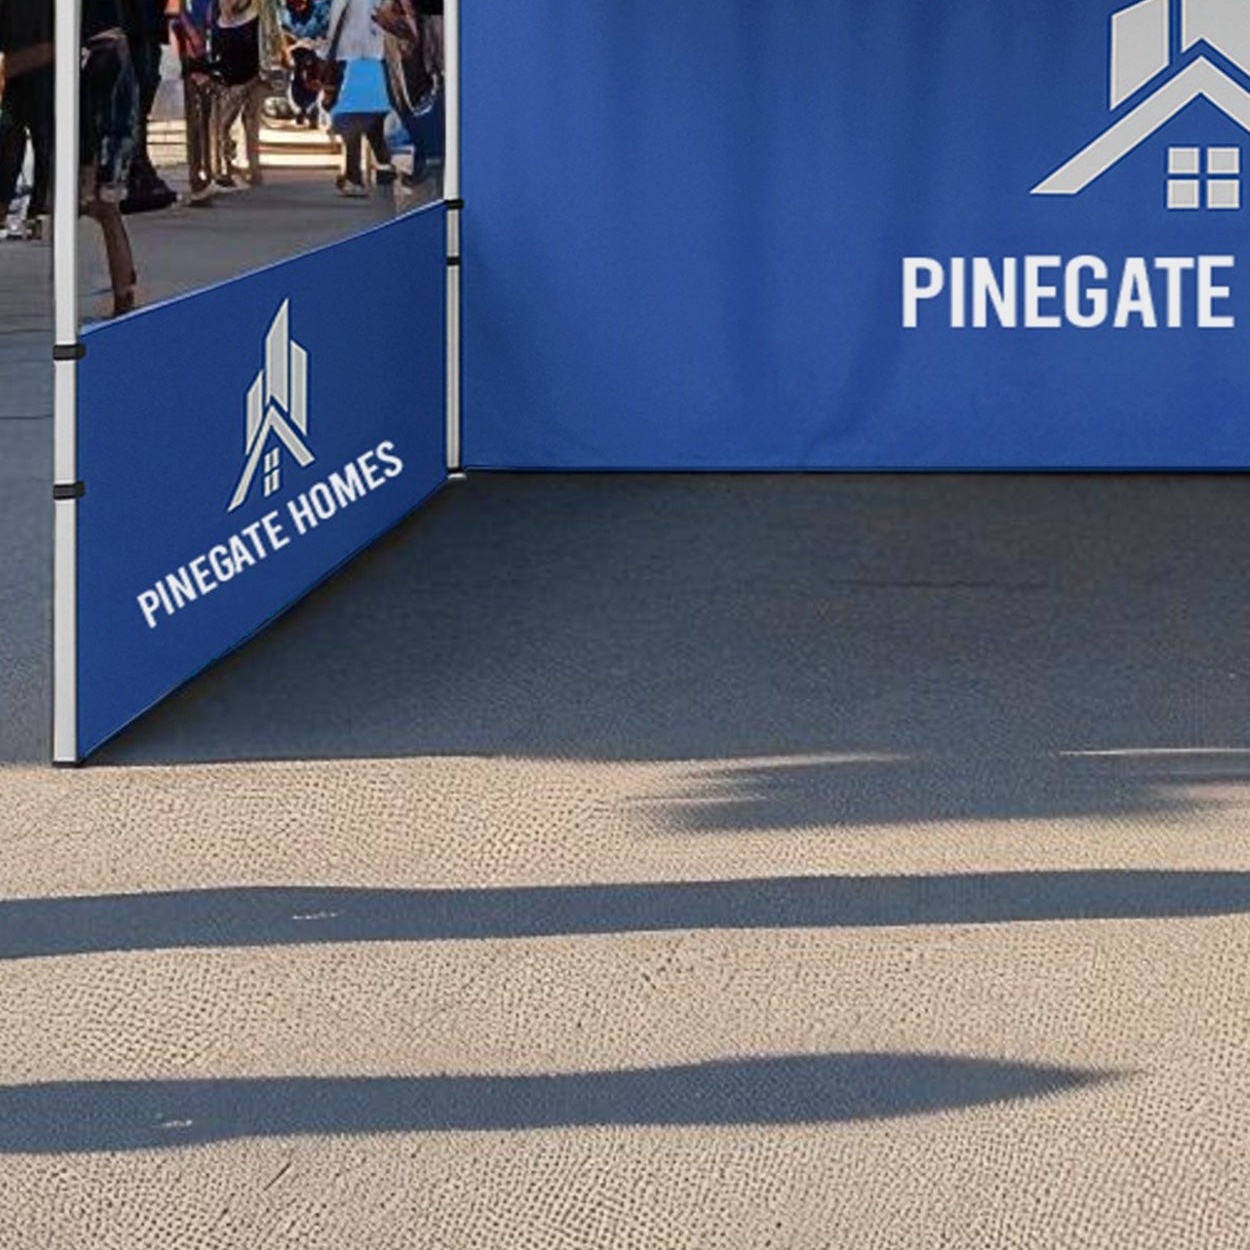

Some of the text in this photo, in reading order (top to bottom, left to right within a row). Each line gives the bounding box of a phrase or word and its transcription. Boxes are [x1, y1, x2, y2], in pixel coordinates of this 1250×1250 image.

[903, 255, 1234, 327] PINEGATE
[138, 442, 402, 627] PINEGATE HOMES
